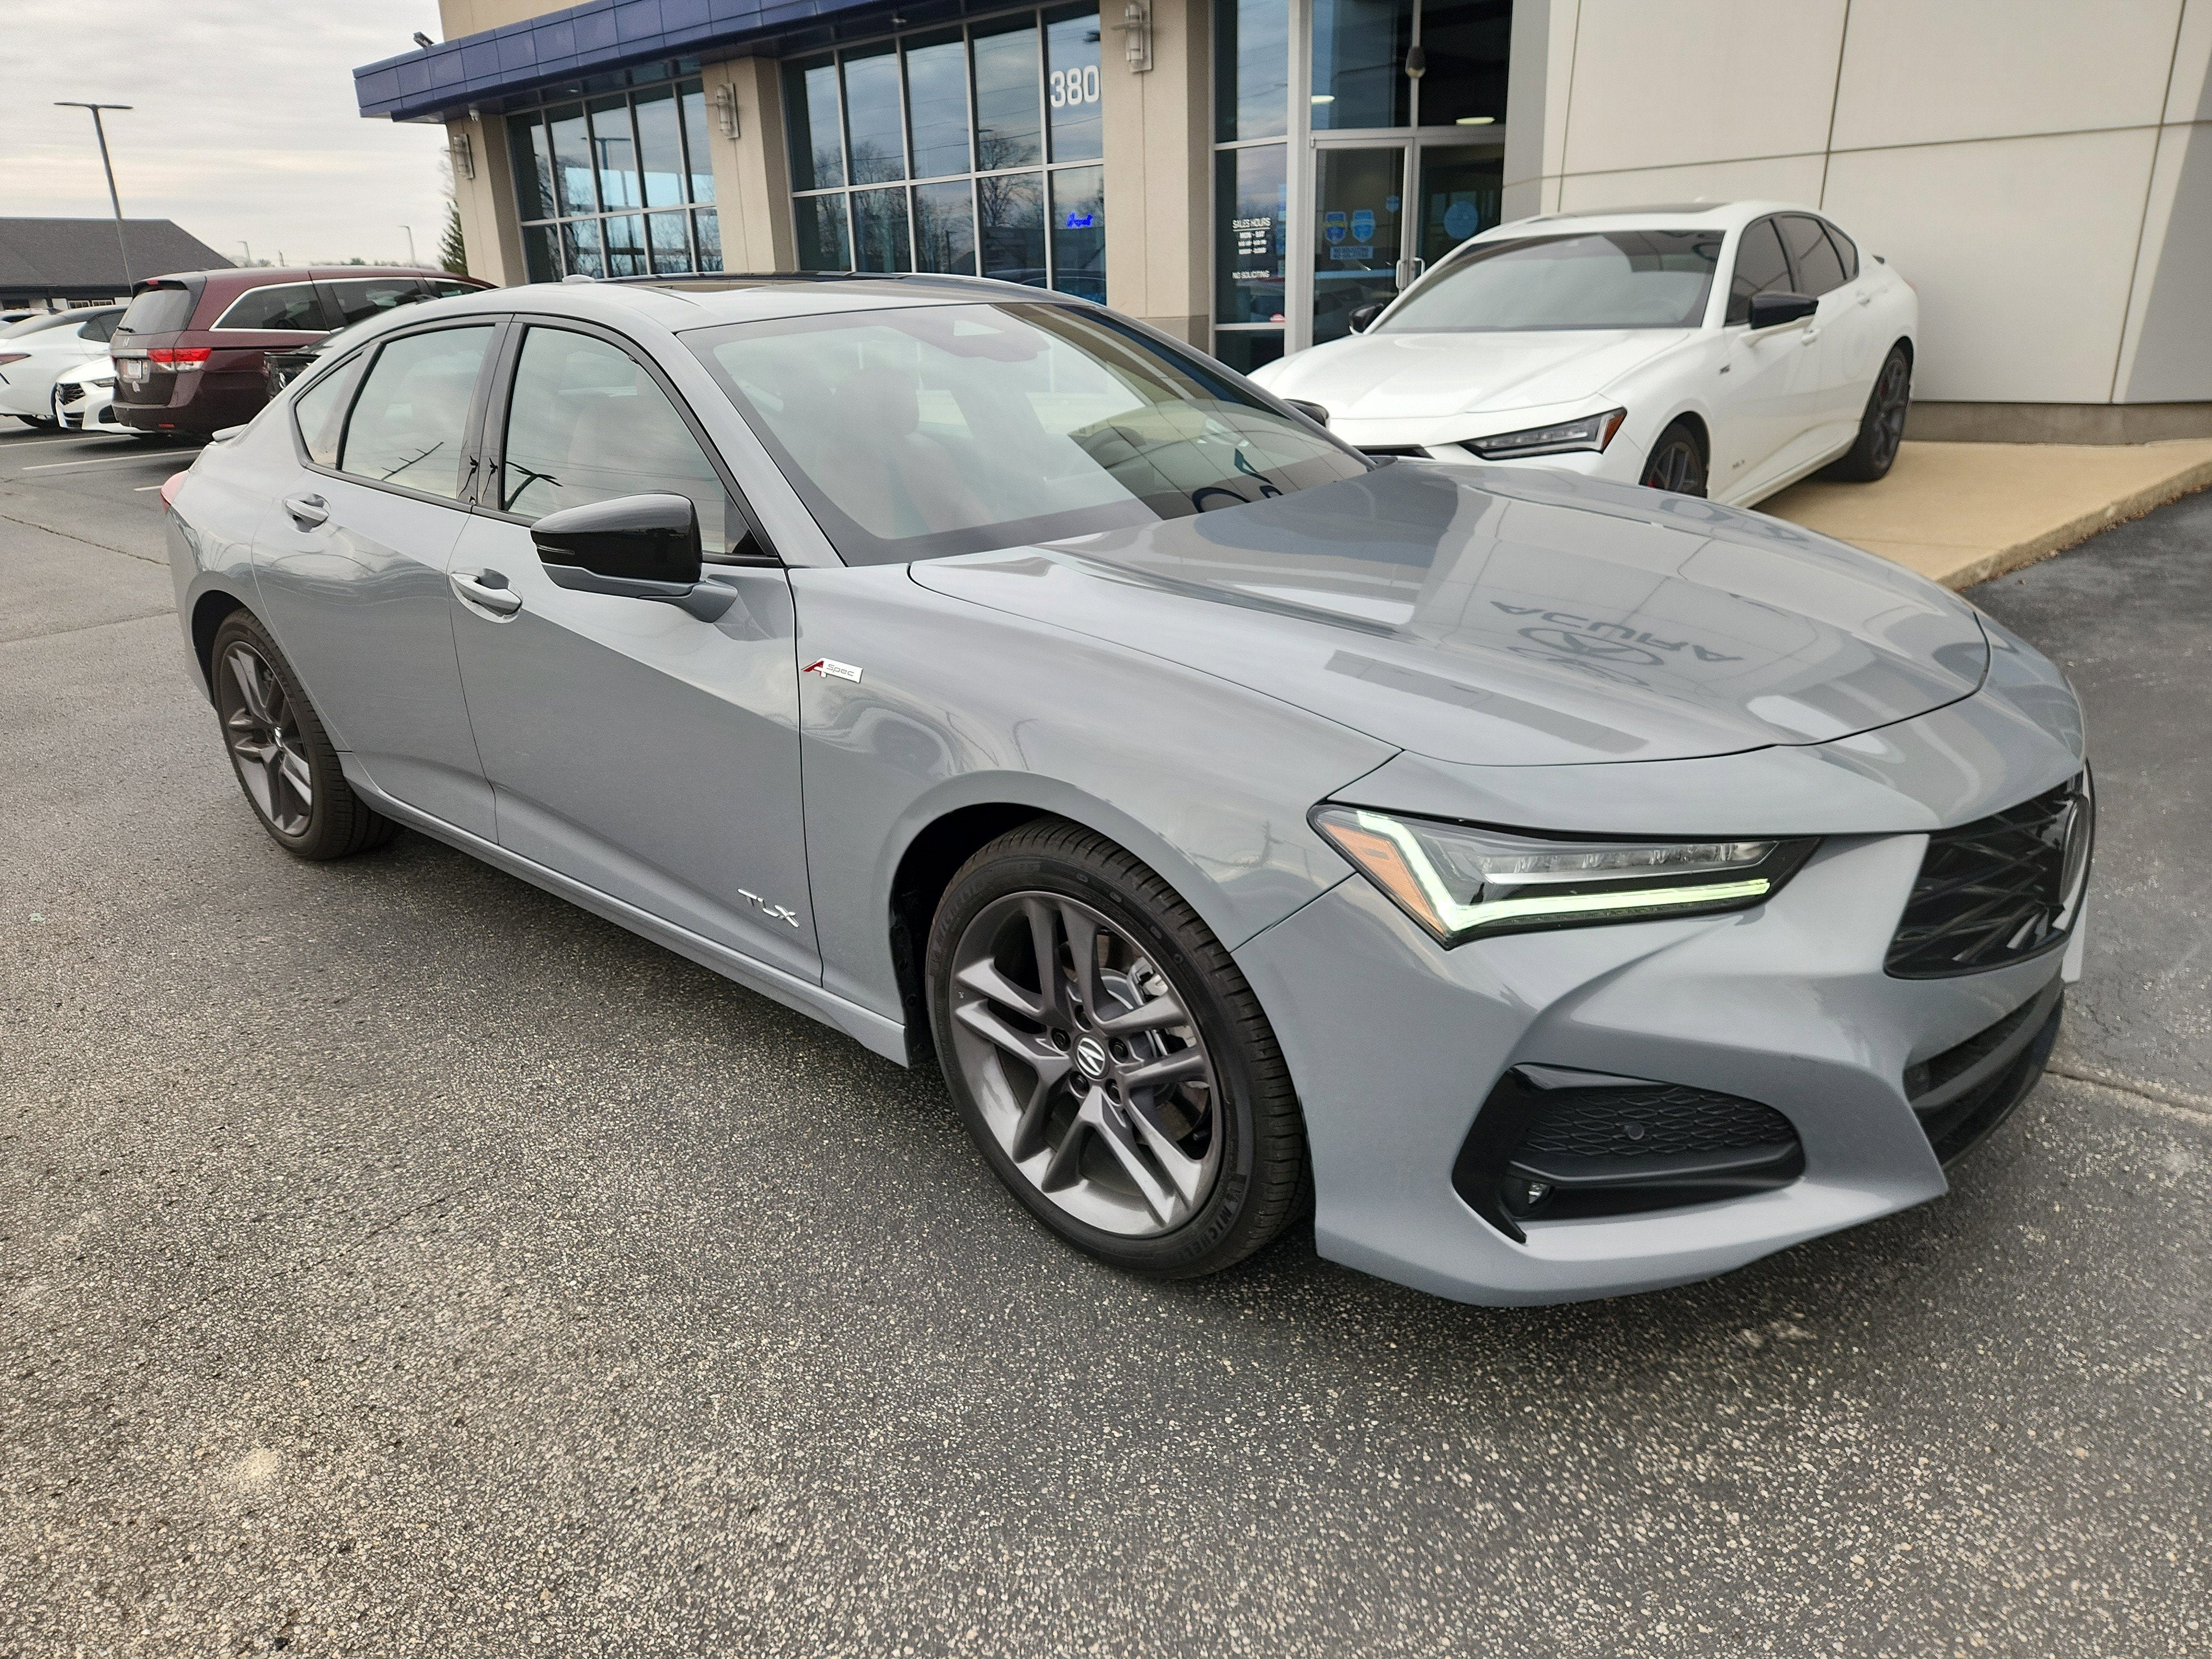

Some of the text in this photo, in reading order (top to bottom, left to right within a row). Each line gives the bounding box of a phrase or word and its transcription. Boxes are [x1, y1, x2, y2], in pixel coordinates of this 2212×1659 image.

[1050, 65, 1100, 107] 380
[1232, 218, 1250, 228] SALES
[826, 663, 855, 677] Spec
[737, 888, 800, 928] TLX
[1172, 1205, 1233, 1263] MICHELI
